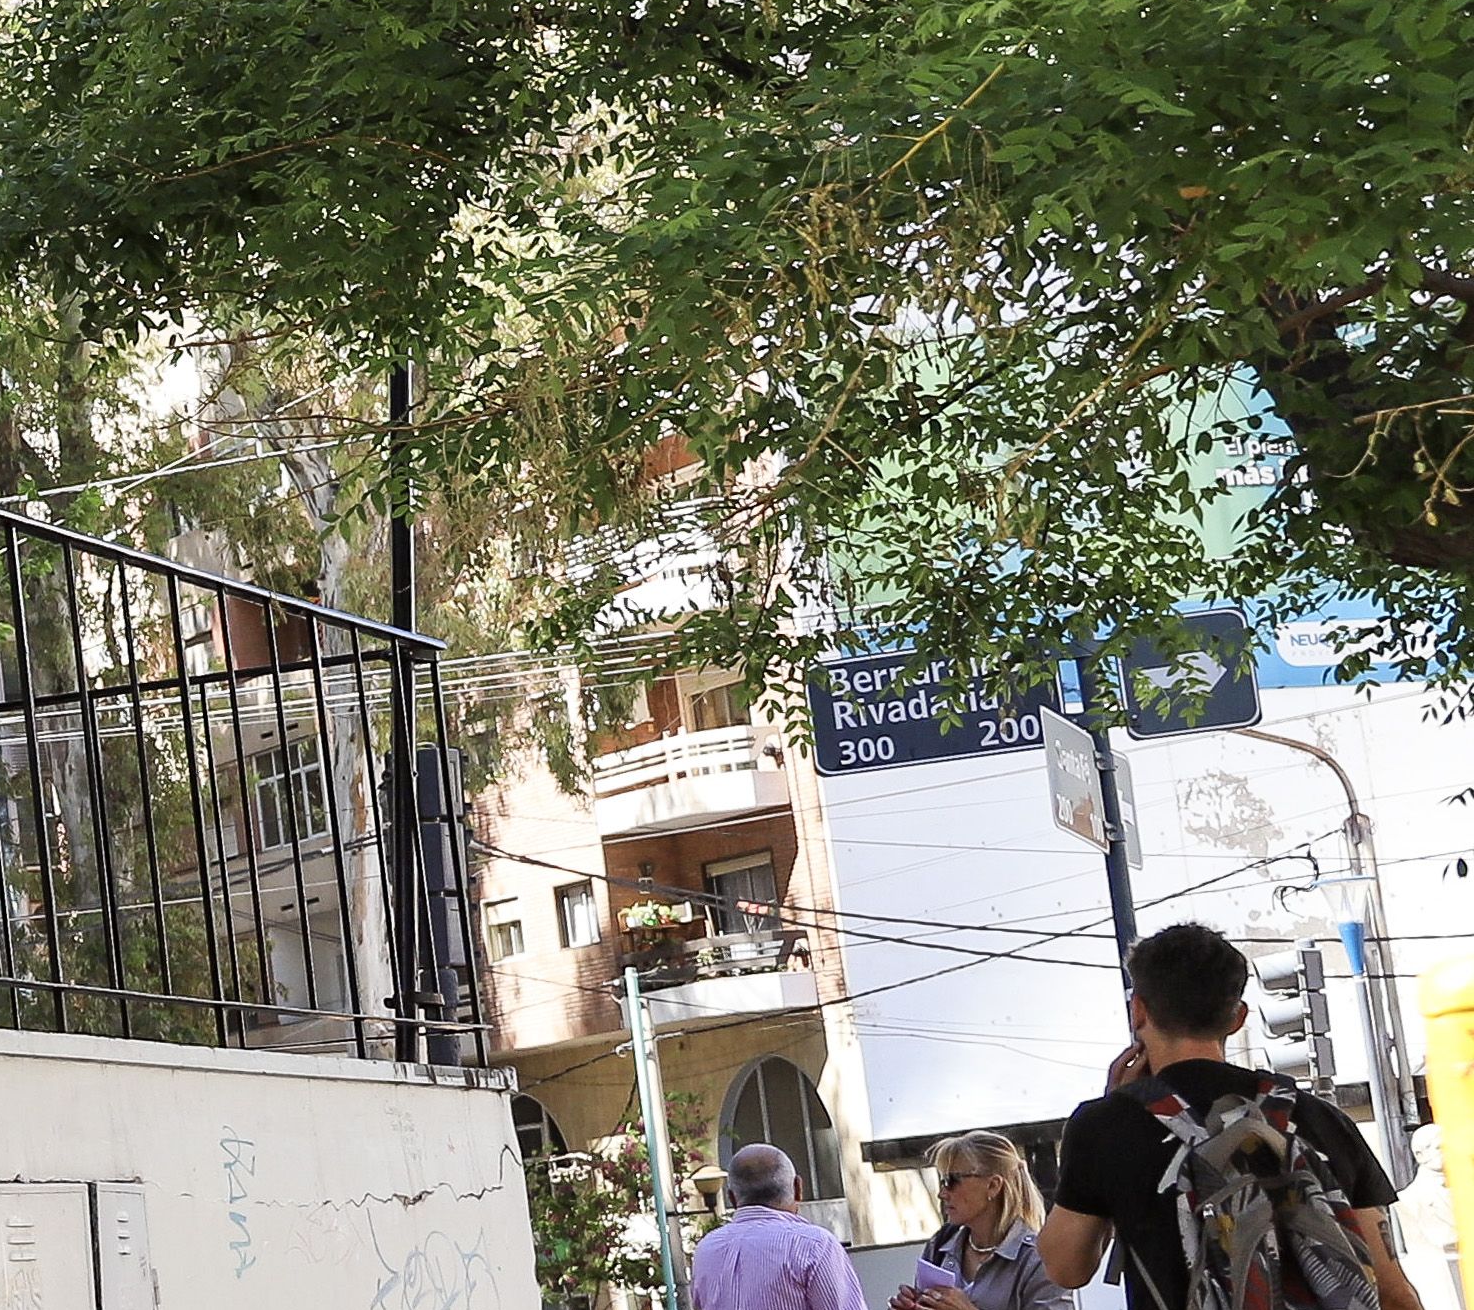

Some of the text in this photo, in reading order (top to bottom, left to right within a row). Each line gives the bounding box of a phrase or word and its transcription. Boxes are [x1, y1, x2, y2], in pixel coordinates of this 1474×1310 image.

[1215, 458, 1276, 486] más
[838, 713, 1040, 766] 300 200
